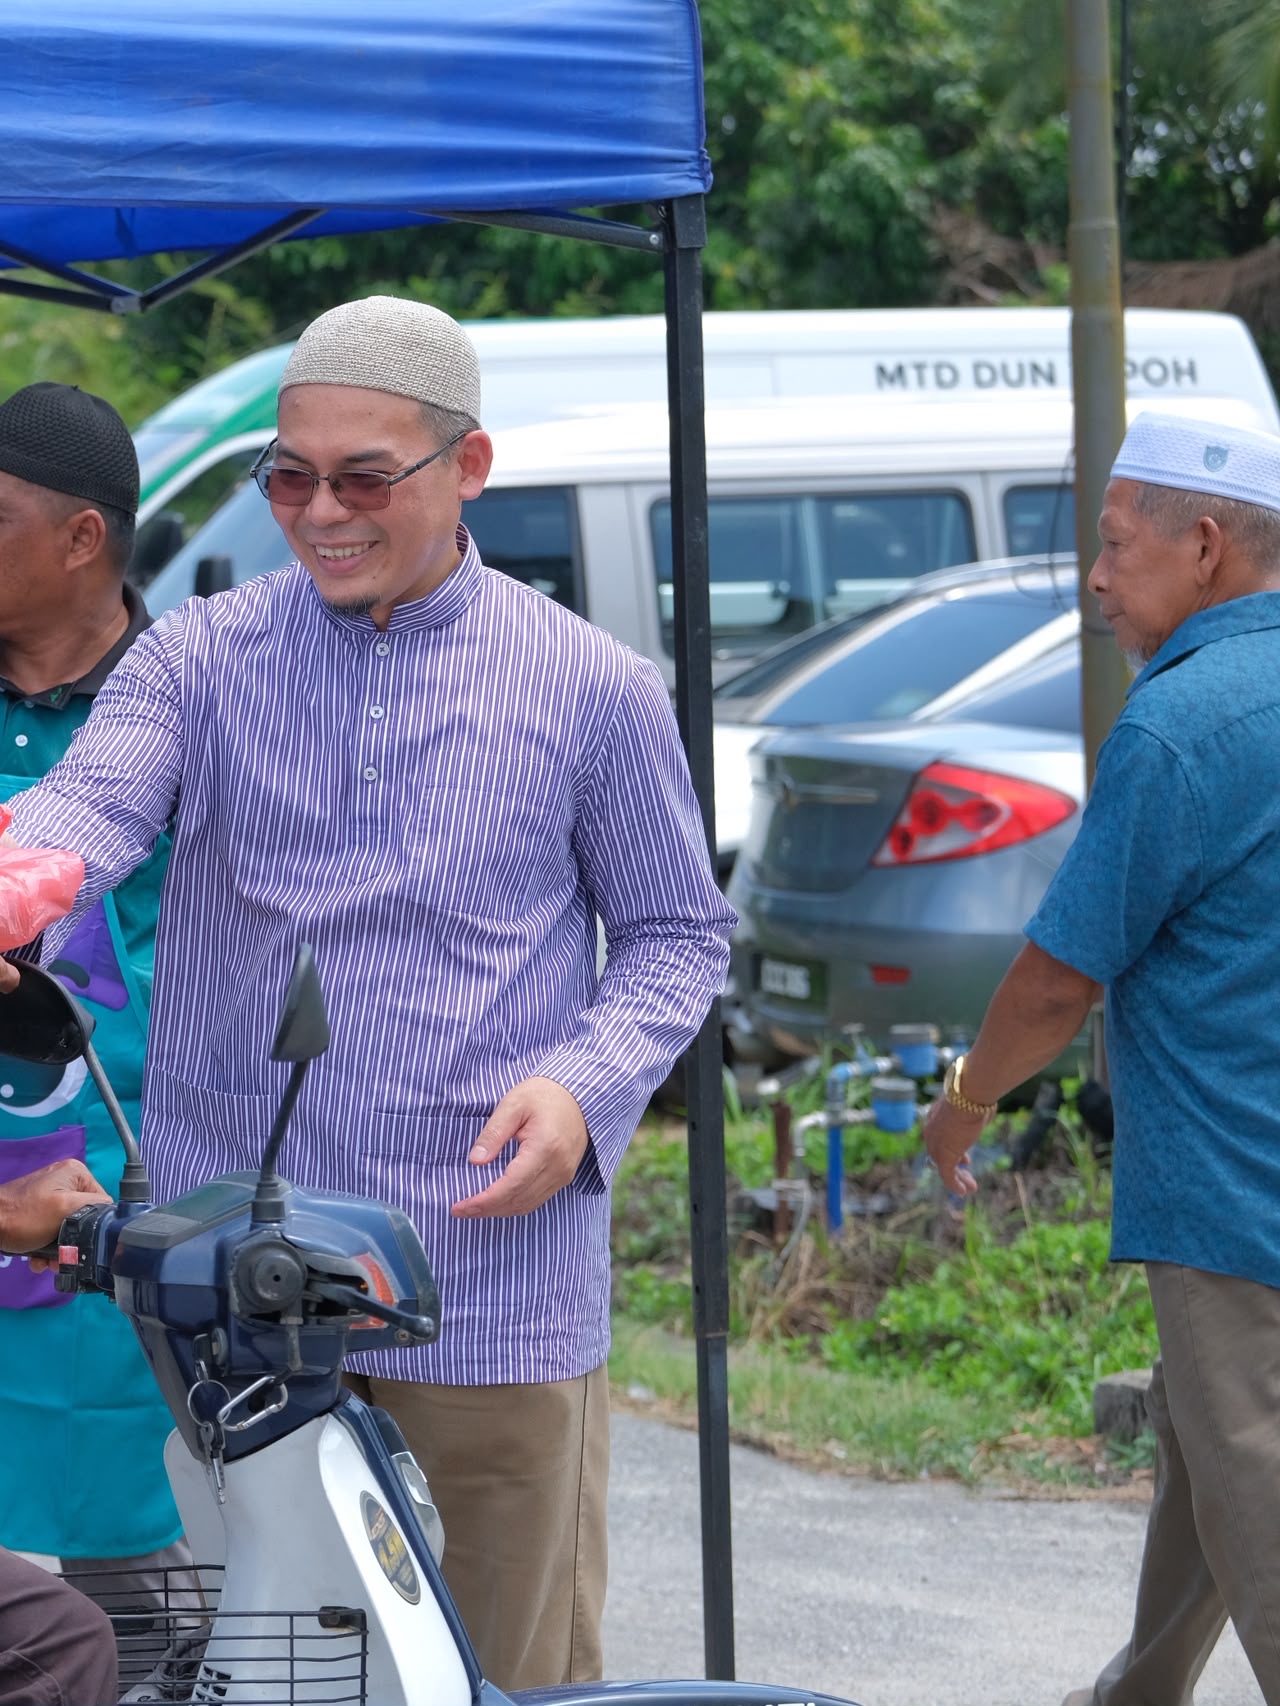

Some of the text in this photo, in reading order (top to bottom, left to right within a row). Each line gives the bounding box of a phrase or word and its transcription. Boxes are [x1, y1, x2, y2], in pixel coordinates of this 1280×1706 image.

[876, 357, 1197, 390] MTD DUN POH
